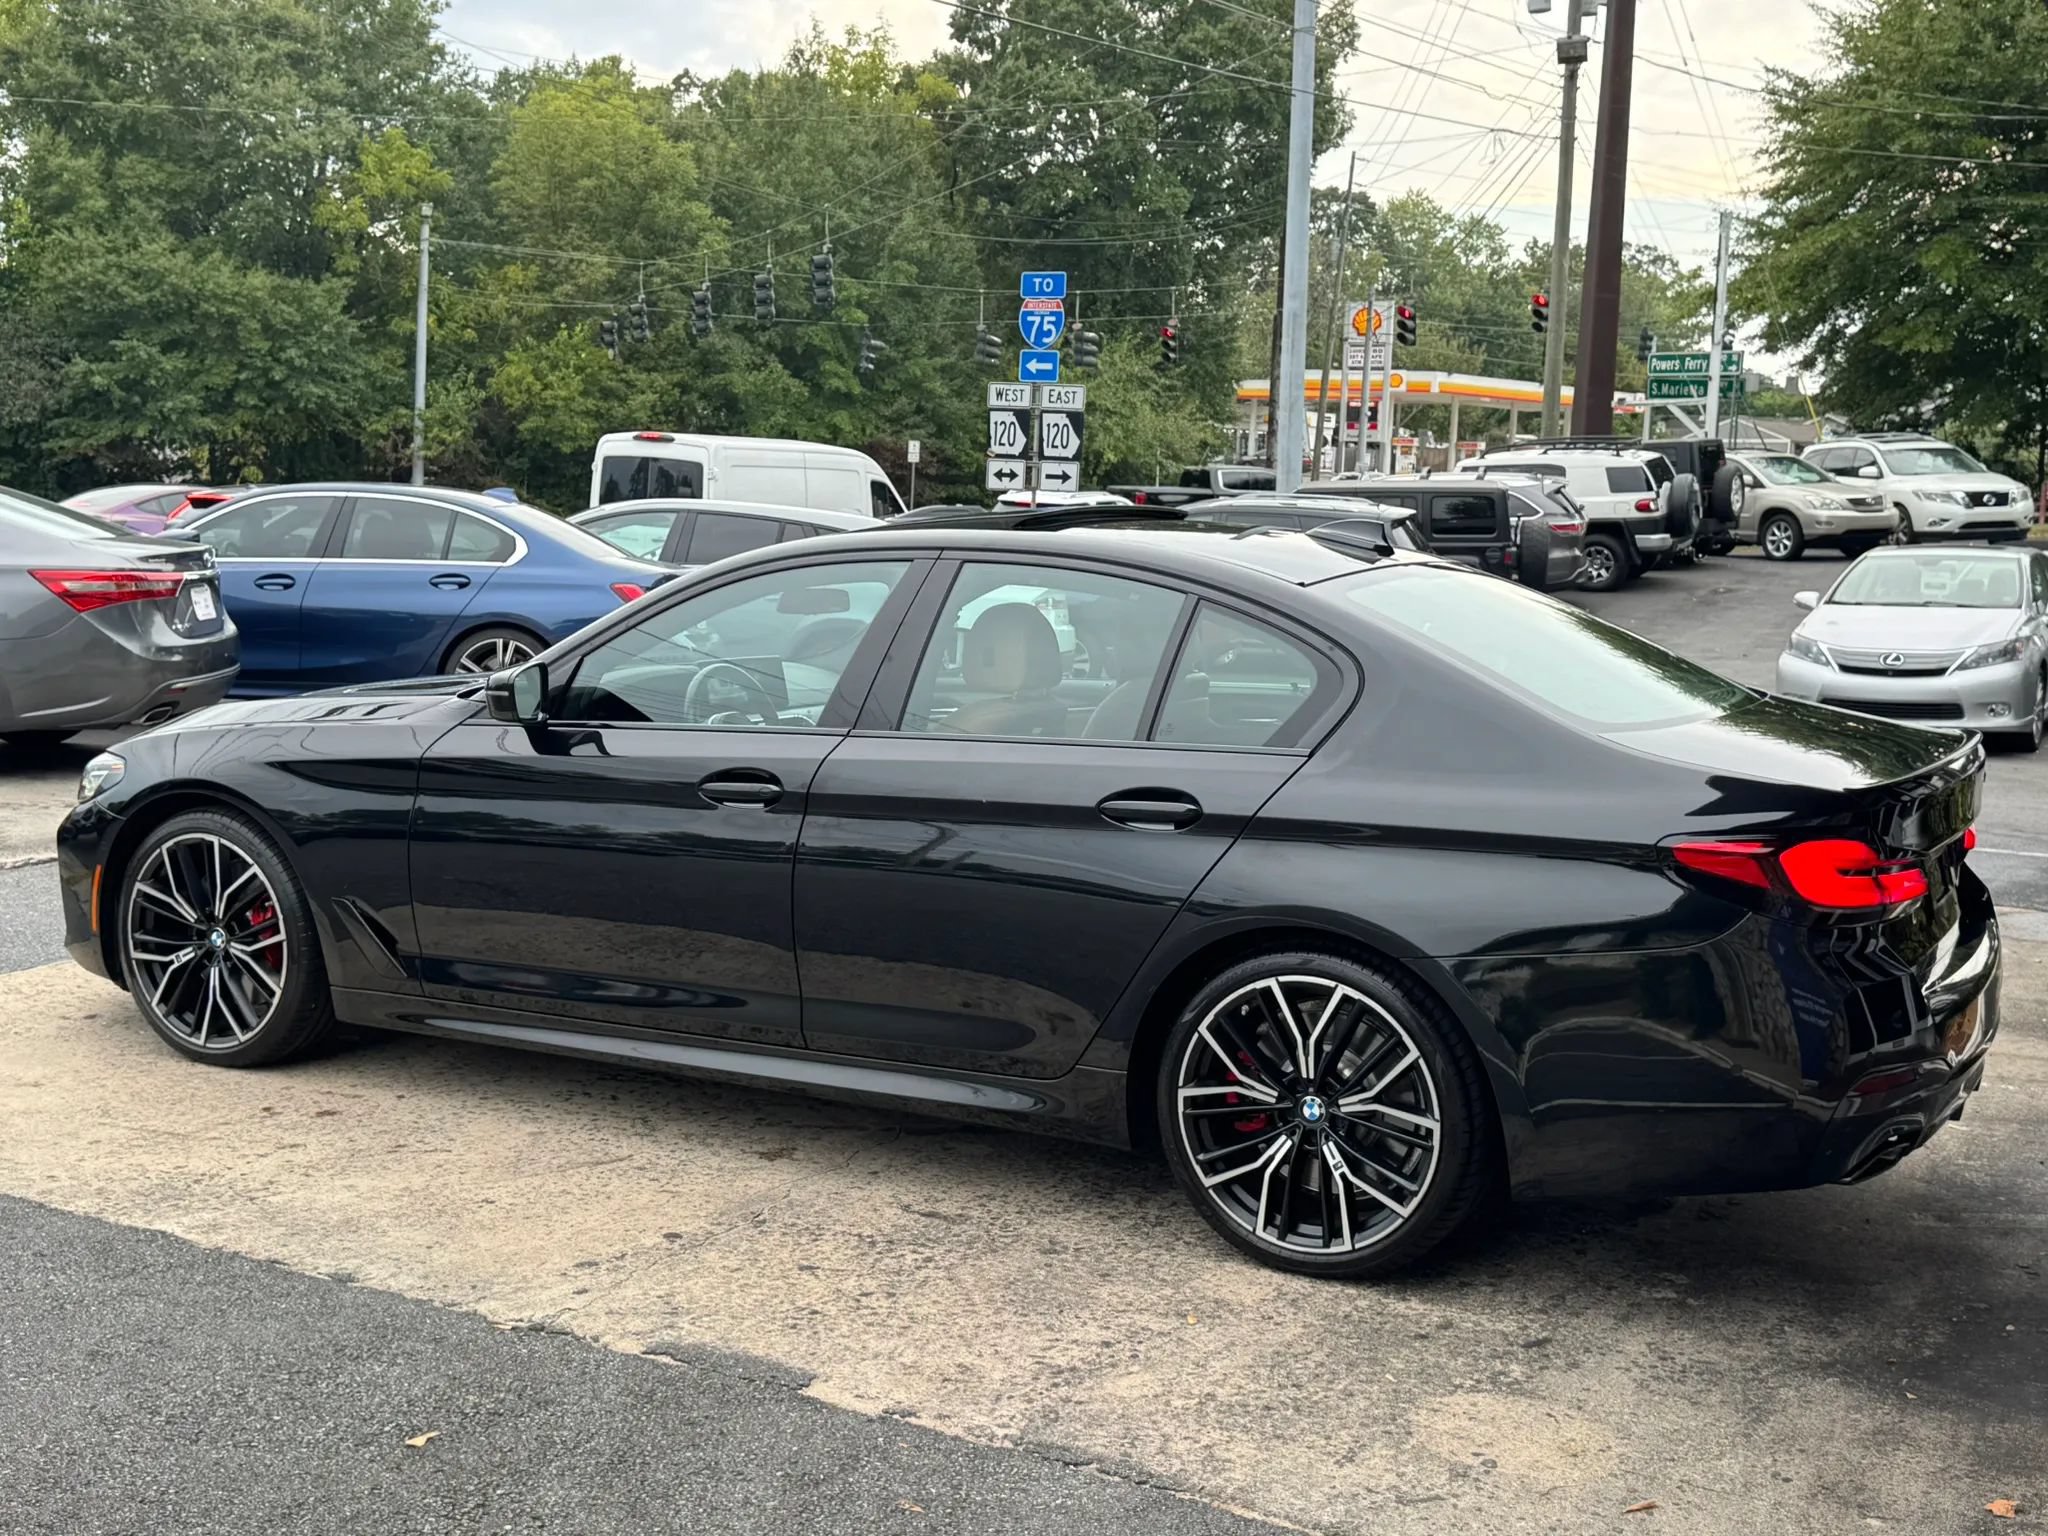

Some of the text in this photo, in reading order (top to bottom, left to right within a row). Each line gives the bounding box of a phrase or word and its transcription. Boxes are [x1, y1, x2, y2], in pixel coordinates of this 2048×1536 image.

[1032, 277, 1054, 293] TO
[1026, 315, 1057, 344] 75
[1651, 358, 1680, 370] Powers
[1684, 357, 1708, 372] Ferry
[995, 387, 1025, 403] WEST
[1048, 389, 1077, 405] EAST
[994, 421, 1017, 447] 120
[1046, 423, 1070, 449] 120
